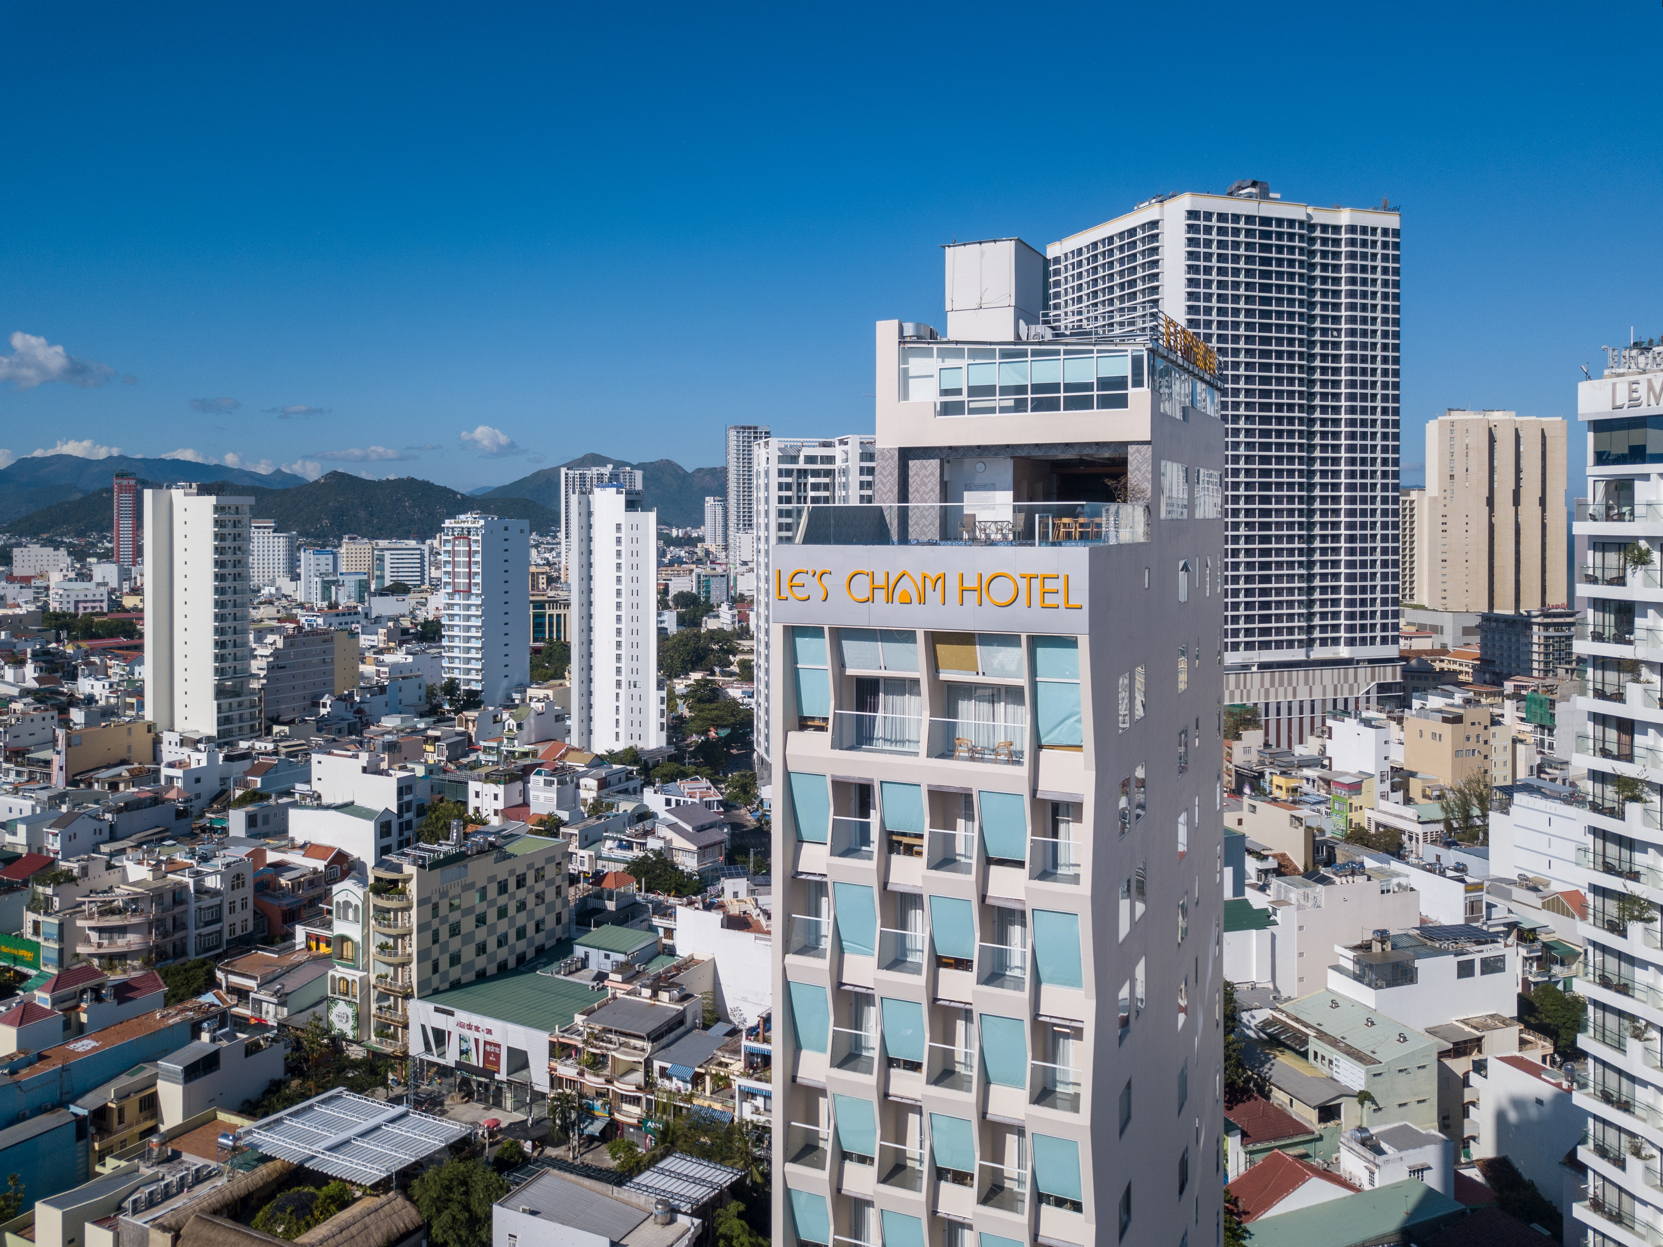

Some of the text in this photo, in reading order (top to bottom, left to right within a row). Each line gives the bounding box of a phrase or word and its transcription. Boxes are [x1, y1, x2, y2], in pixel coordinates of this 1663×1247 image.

[776, 568, 1083, 610] LE'S CHAM HOTEL
